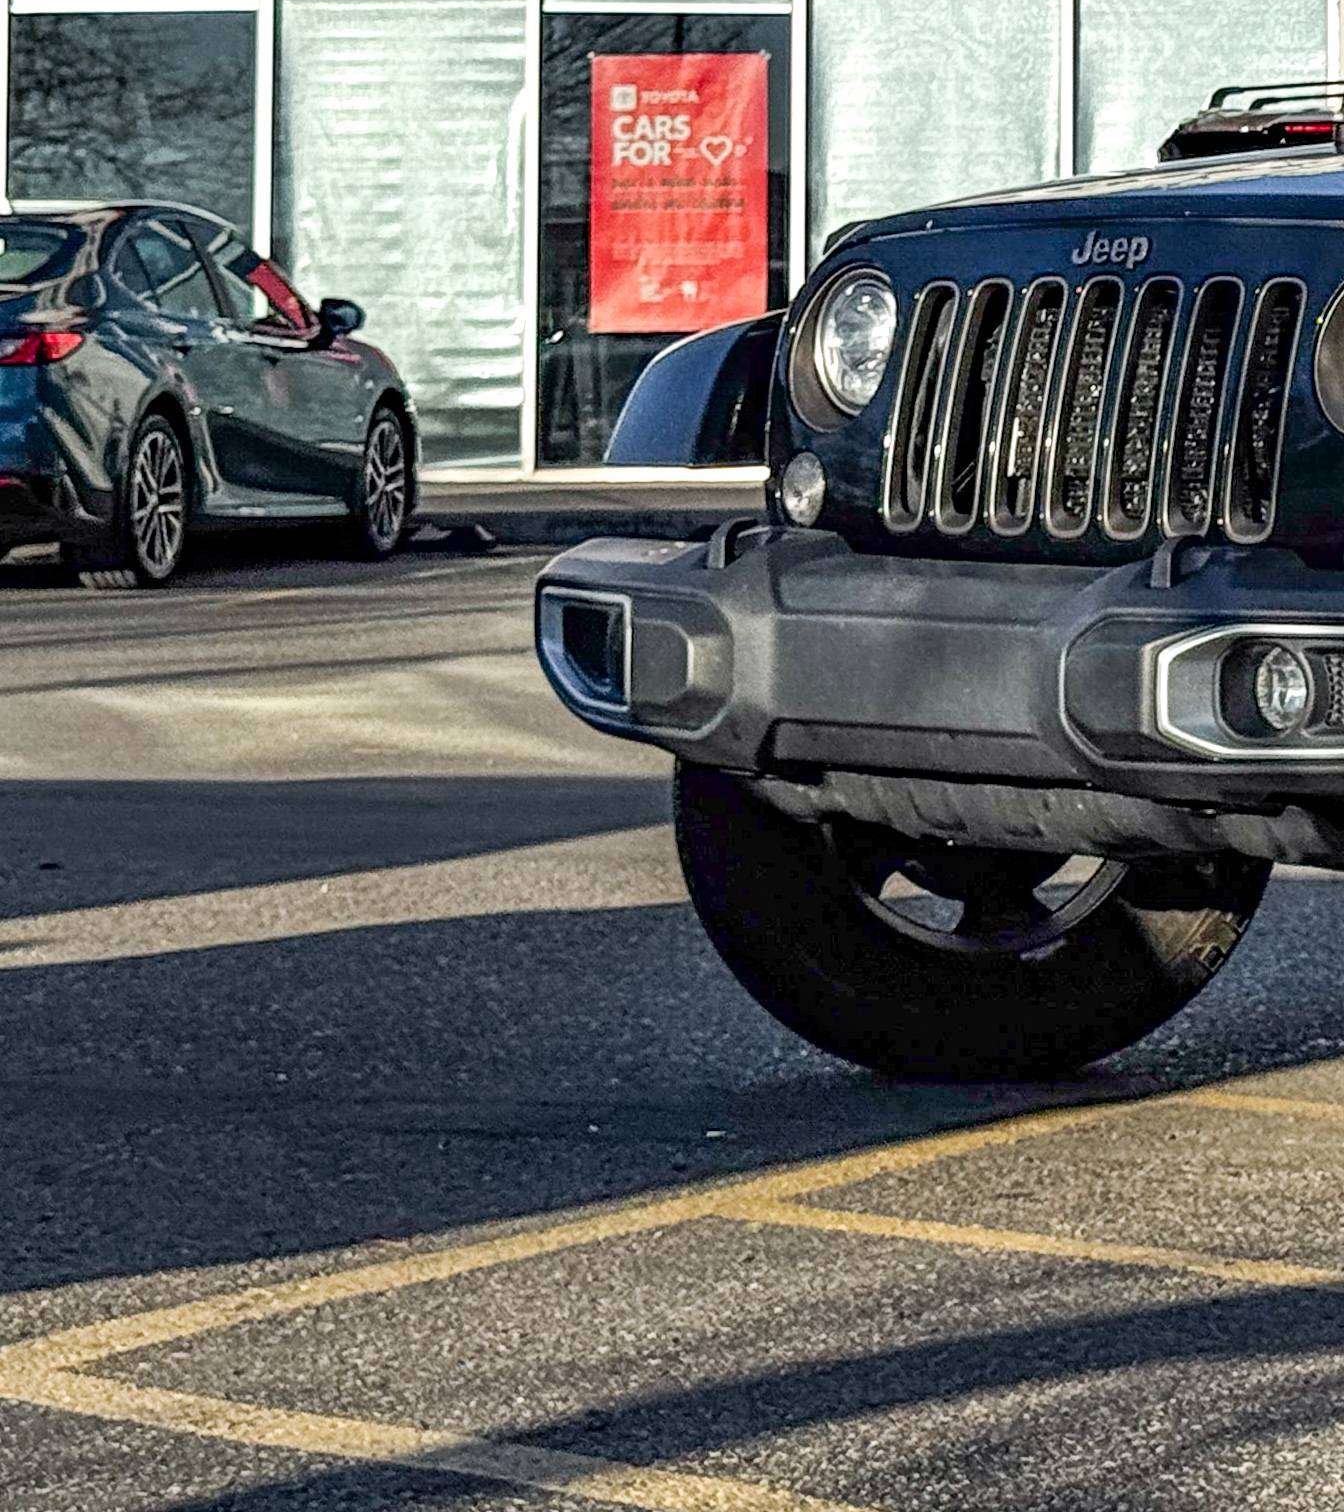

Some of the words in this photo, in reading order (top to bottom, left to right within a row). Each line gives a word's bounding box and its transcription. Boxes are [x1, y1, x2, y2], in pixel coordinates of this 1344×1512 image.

[612, 114, 692, 141] CARS
[611, 140, 672, 166] FOR
[1071, 229, 1149, 270] Jeep
